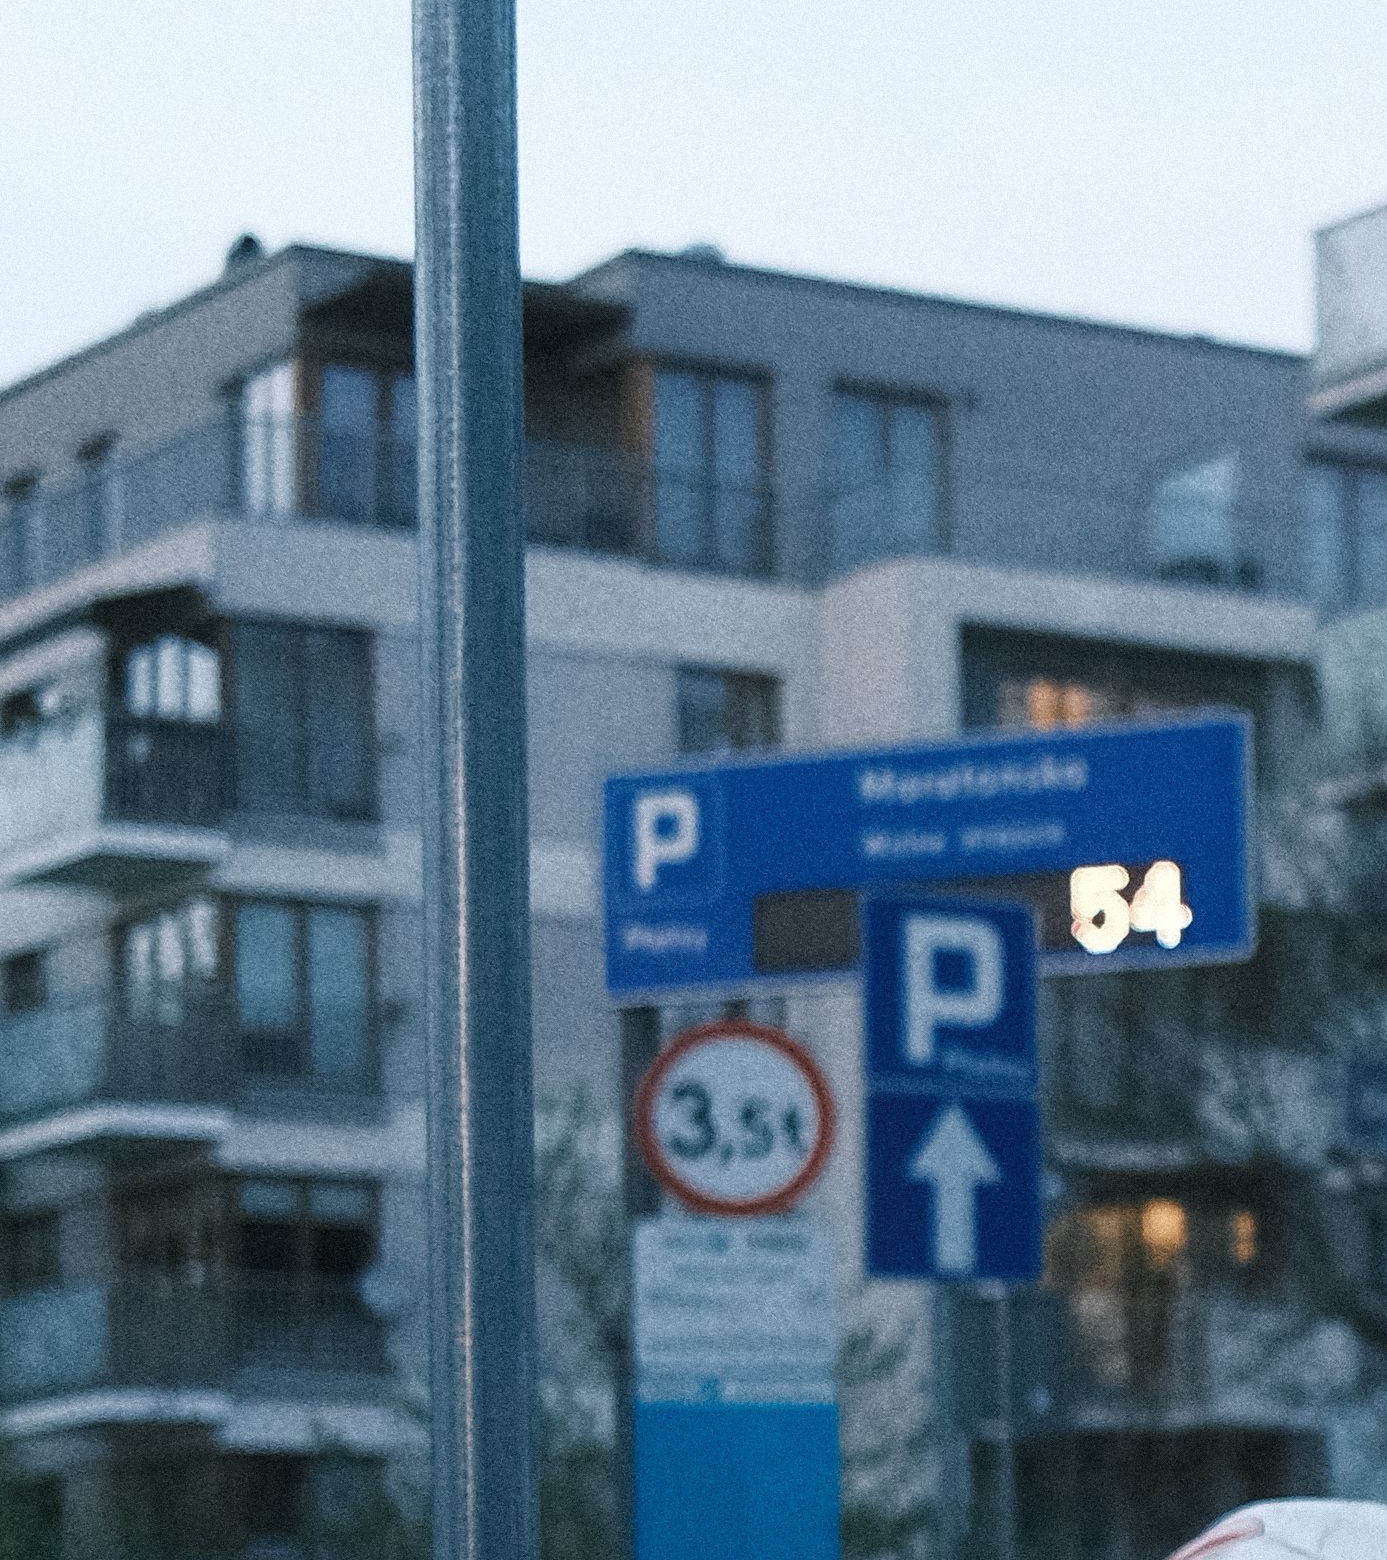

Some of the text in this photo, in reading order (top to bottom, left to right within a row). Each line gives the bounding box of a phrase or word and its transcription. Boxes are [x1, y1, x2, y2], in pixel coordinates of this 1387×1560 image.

[634, 789, 698, 891] P
[1069, 859, 1193, 955] 54
[904, 916, 1003, 1064] P
